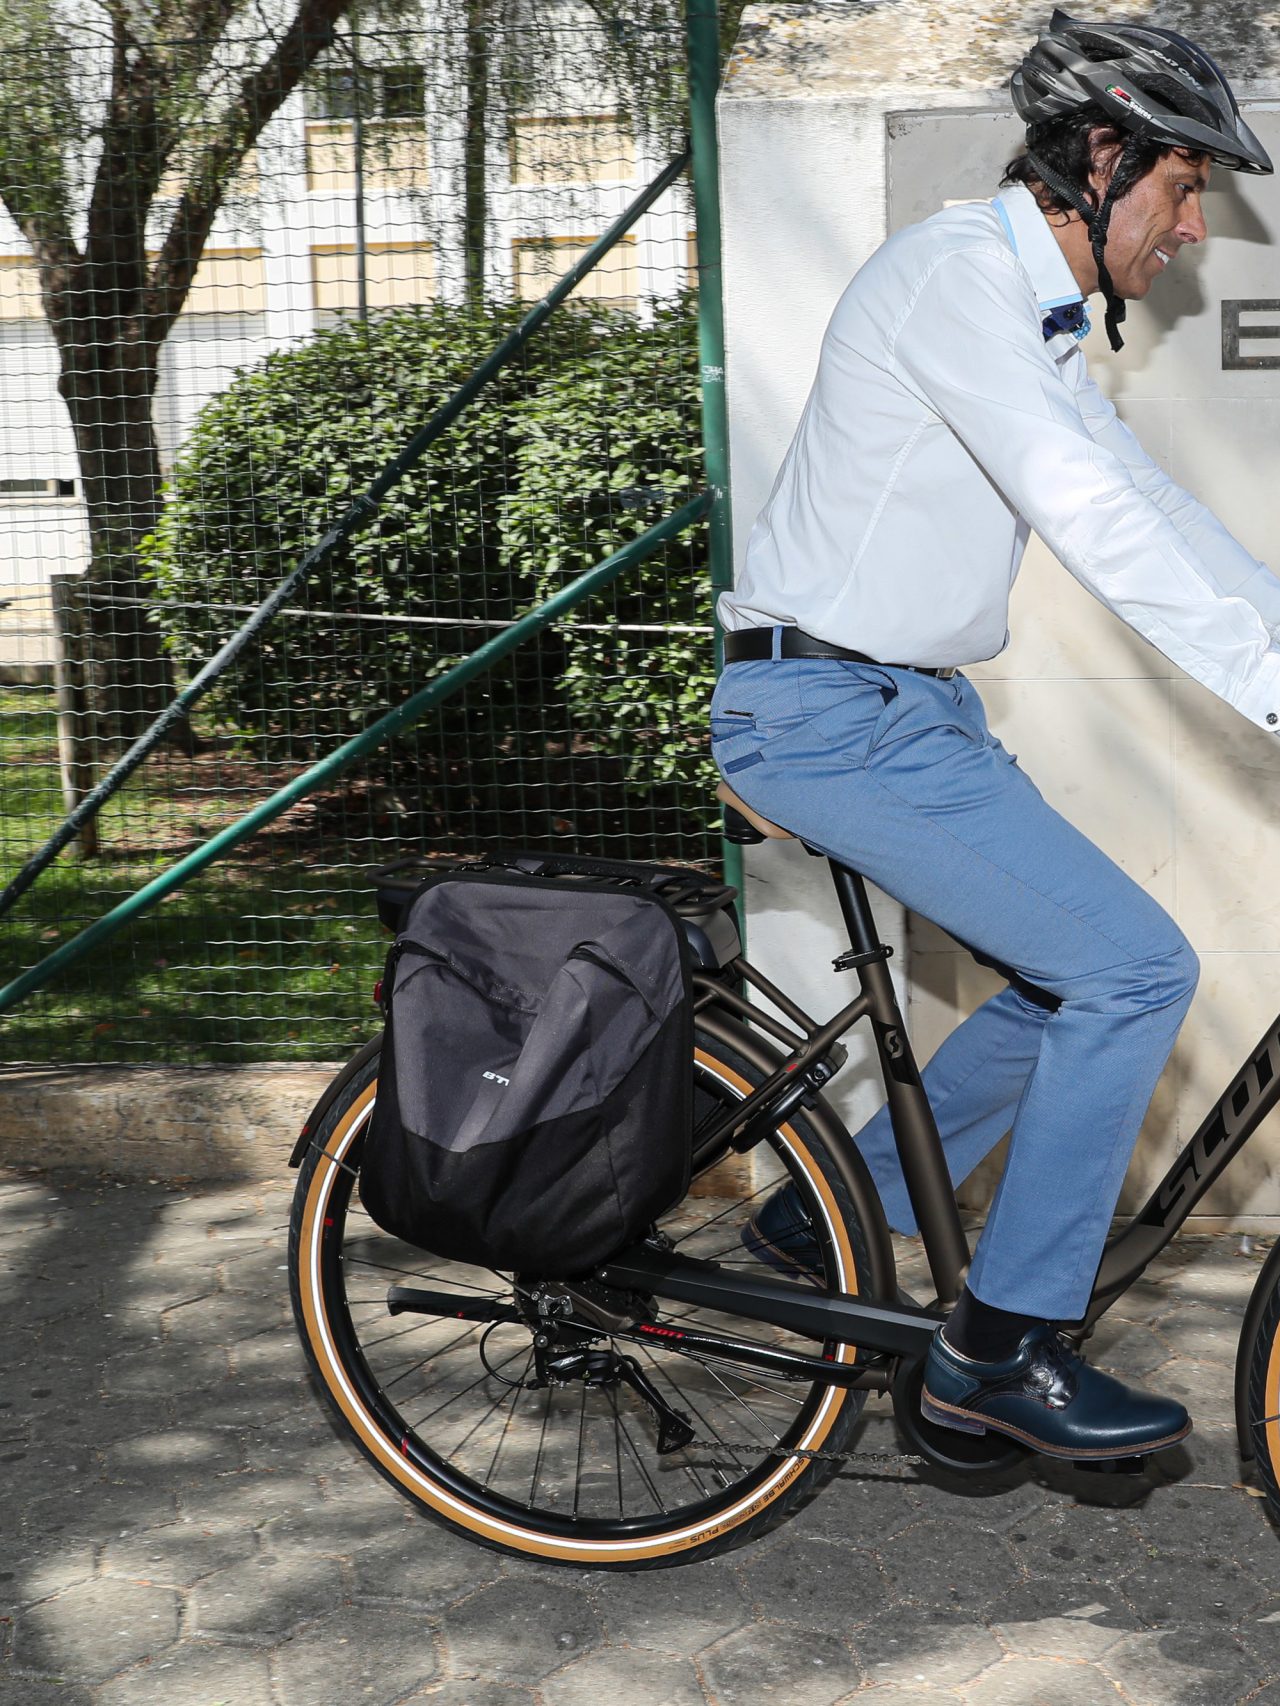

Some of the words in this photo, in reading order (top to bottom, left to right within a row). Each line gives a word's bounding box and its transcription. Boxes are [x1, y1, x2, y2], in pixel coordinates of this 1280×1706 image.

[640, 1324, 685, 1339] SCOTT
[762, 1457, 805, 1503] SCHWALBE
[690, 1526, 720, 1543] PLUS
